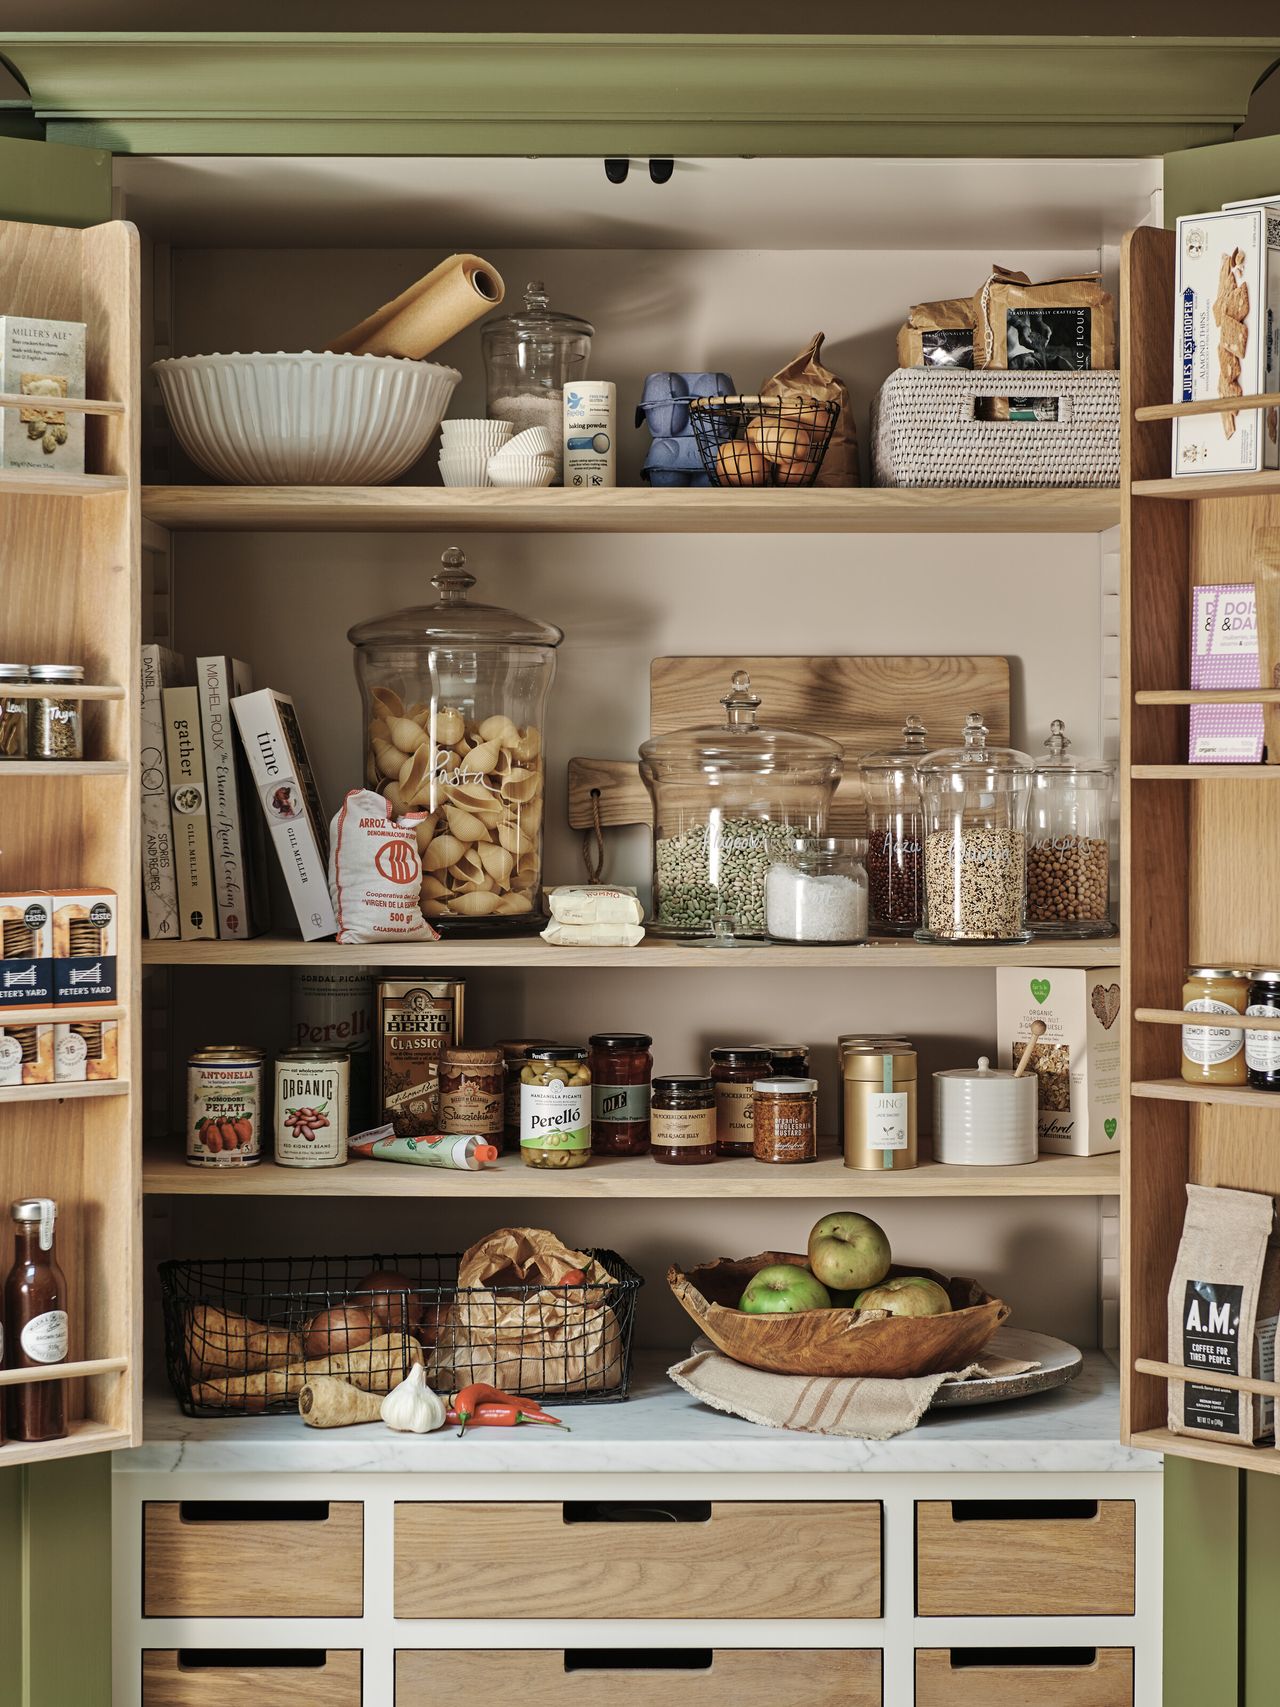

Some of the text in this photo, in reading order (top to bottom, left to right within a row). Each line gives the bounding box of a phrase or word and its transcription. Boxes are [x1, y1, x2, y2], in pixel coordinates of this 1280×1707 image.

[12, 329, 67, 340] MILLER'S ALE
[1077, 310, 1086, 347] FLOUR
[1183, 301, 1194, 394] JULES DESTROOPER
[1224, 602, 1257, 615] DOIS
[143, 657, 155, 689] DANIEL
[206, 664, 225, 750] MICHEL ROUX
[173, 719, 195, 777] gather
[257, 731, 280, 777] time
[422, 750, 504, 794] Pasta
[216, 765, 228, 810] Essence
[359, 818, 386, 829] ARROZ
[216, 818, 234, 860] French
[158, 834, 169, 868] STORIES
[187, 823, 198, 888] GILL MELLER
[287, 827, 309, 885] GILL MELLER
[147, 834, 161, 891] AND RECIPES
[219, 858, 240, 908] Cooking
[365, 891, 403, 899] Cooperativa
[25, 913, 47, 922] taste
[90, 912, 112, 920] taste
[389, 912, 404, 922] 500
[0, 989, 48, 998] ETER'S YARD
[59, 986, 112, 996] PETER'S YARD
[1028, 1009, 1053, 1017] ORGANIC
[387, 1021, 450, 1032] BERIO
[390, 1036, 446, 1049] CLASSICO
[65, 1045, 76, 1055] 16
[199, 1071, 254, 1080] ANTONELLA
[283, 1078, 333, 1100] ORGANIC
[205, 1103, 245, 1112] PELATI
[877, 1098, 904, 1109] JING
[531, 1107, 581, 1129] Perelló
[686, 1132, 700, 1140] JELLY
[1186, 1299, 1236, 1336] A.M.
[1192, 1343, 1228, 1356] COFFEE FOR
[1189, 1351, 1231, 1366] TIRED PEOPLE
